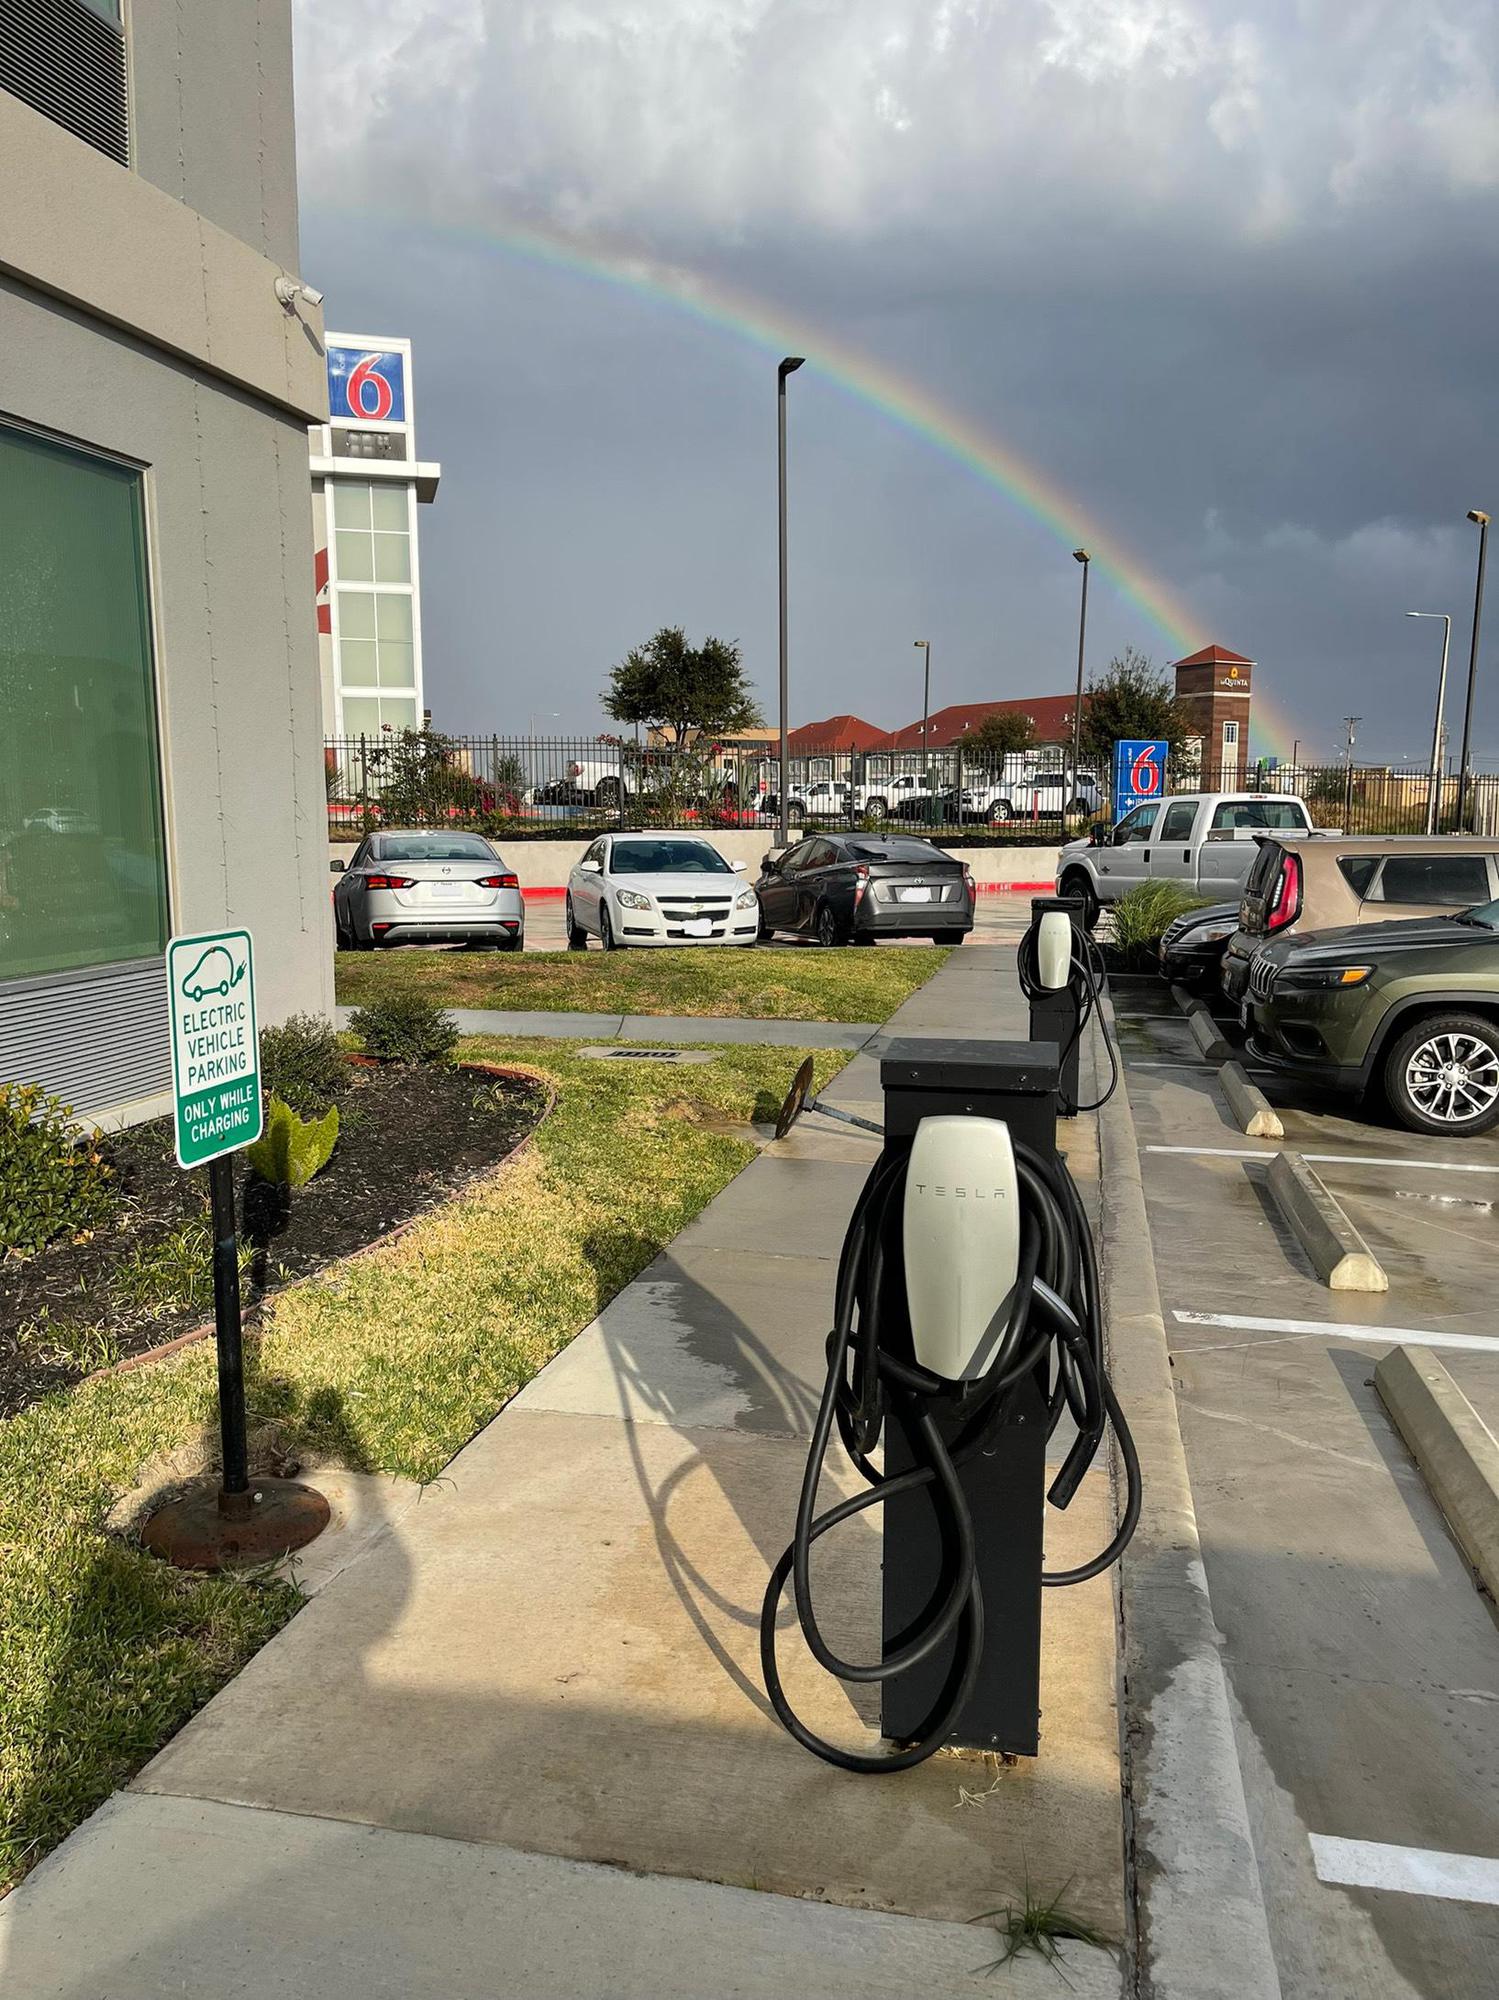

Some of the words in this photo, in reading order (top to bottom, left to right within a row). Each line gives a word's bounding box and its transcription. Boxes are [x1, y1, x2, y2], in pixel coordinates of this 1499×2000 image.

[346, 352, 393, 420] 6
[1130, 745, 1160, 795] 6
[183, 1001, 246, 1035] ELECTRIC
[187, 1026, 245, 1060] VEHICLE
[188, 1051, 247, 1087] PARKING
[184, 1096, 216, 1124] ONLY
[220, 1084, 254, 1110] WHILE
[191, 1107, 250, 1143] CHARGING
[915, 1184, 1006, 1199] TESLA
